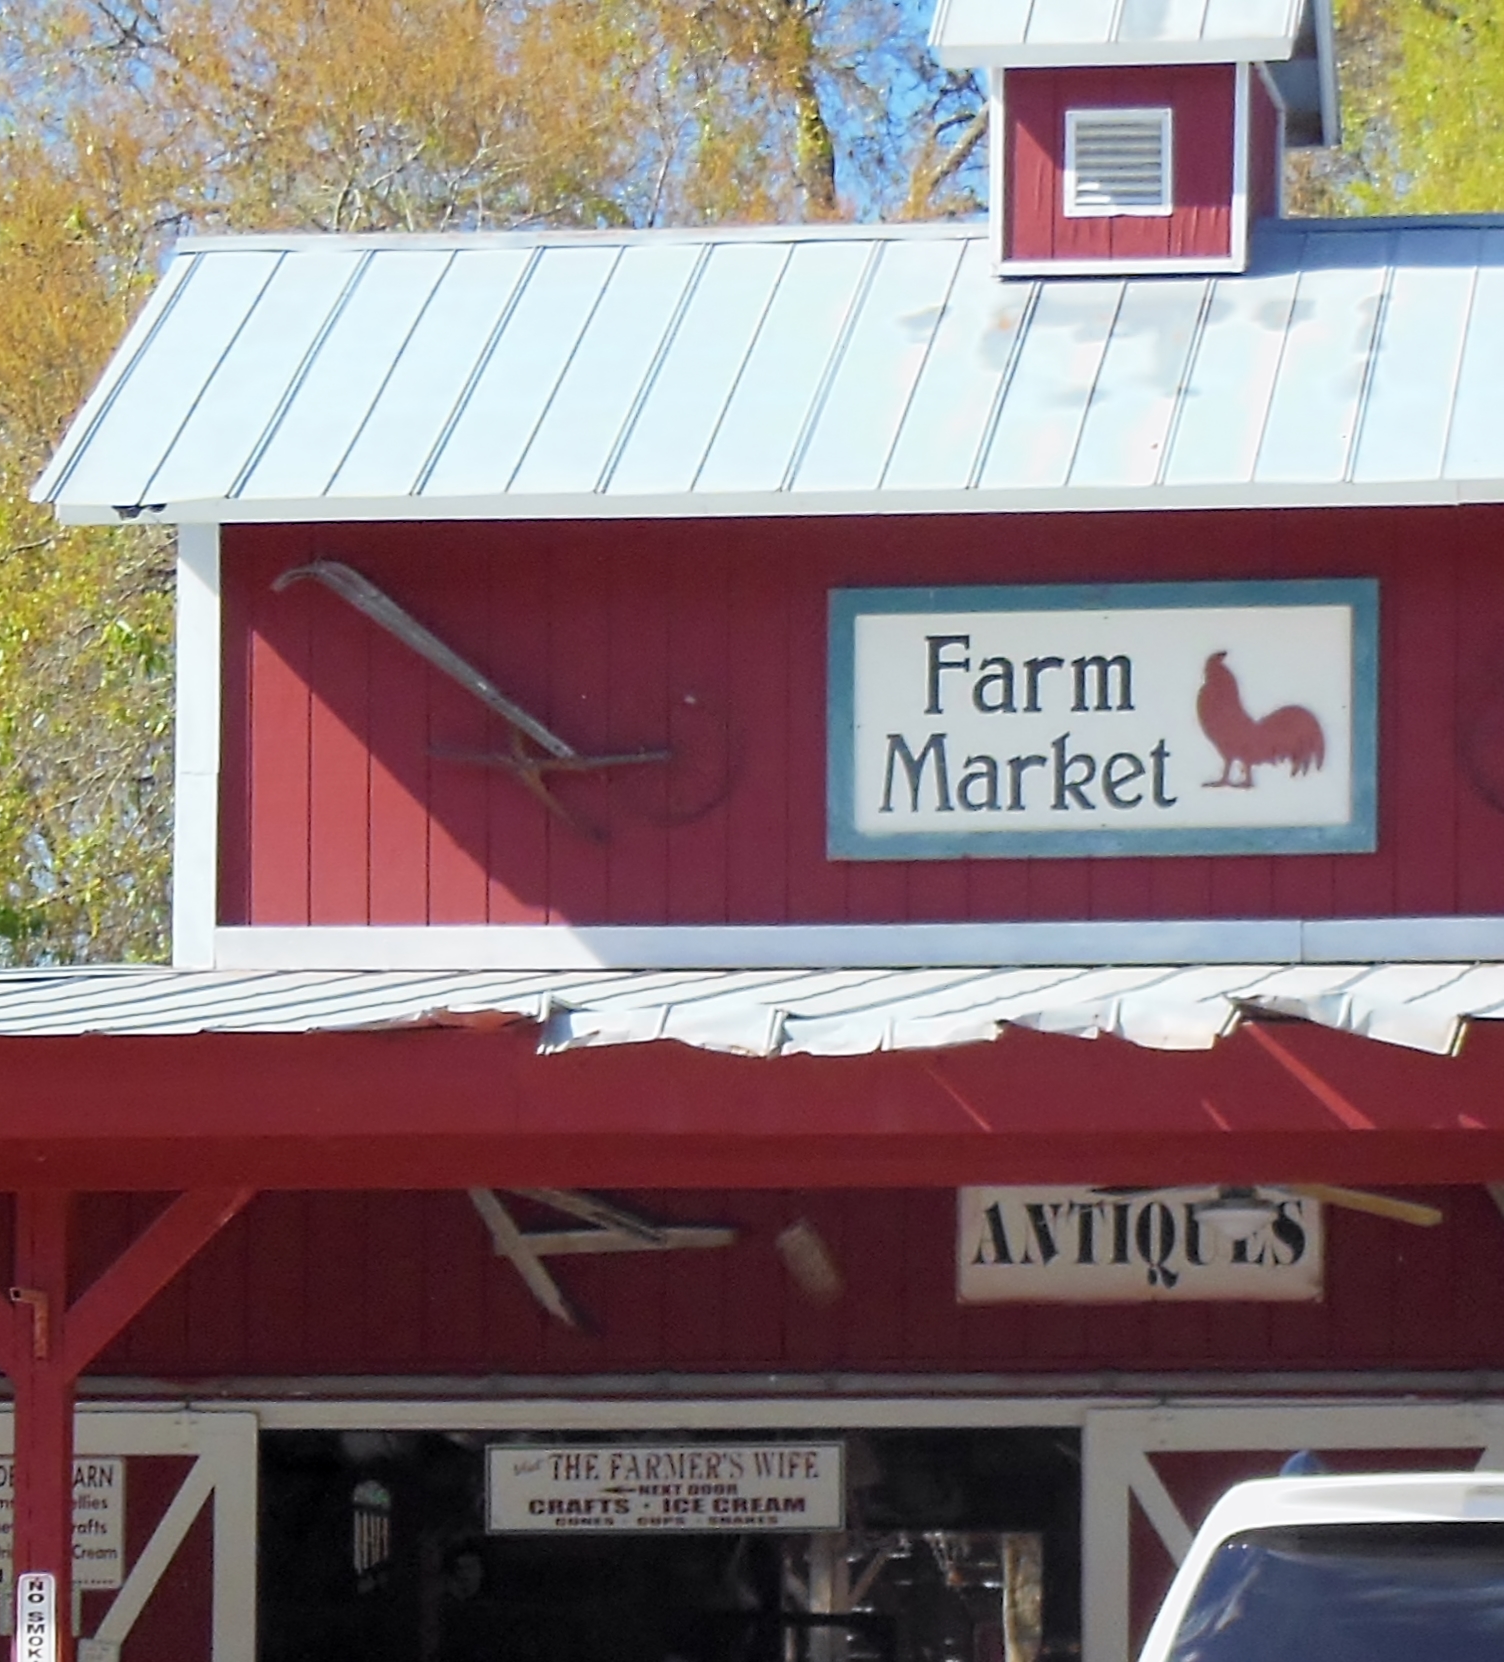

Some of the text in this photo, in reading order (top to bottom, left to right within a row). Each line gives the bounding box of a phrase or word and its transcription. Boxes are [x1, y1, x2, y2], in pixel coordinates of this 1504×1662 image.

[924, 634, 1135, 715] Farm
[878, 732, 1178, 813] Market
[73, 1464, 114, 1488] ARN
[549, 1452, 599, 1480] THE
[610, 1452, 744, 1480] FARMER'S
[753, 1450, 820, 1480] WIFE
[638, 1483, 738, 1496] NEXT DOOR
[528, 1497, 806, 1515] CRAFTS ICE CREAM
[72, 1518, 108, 1535] rafts
[27, 1580, 45, 1604] NO
